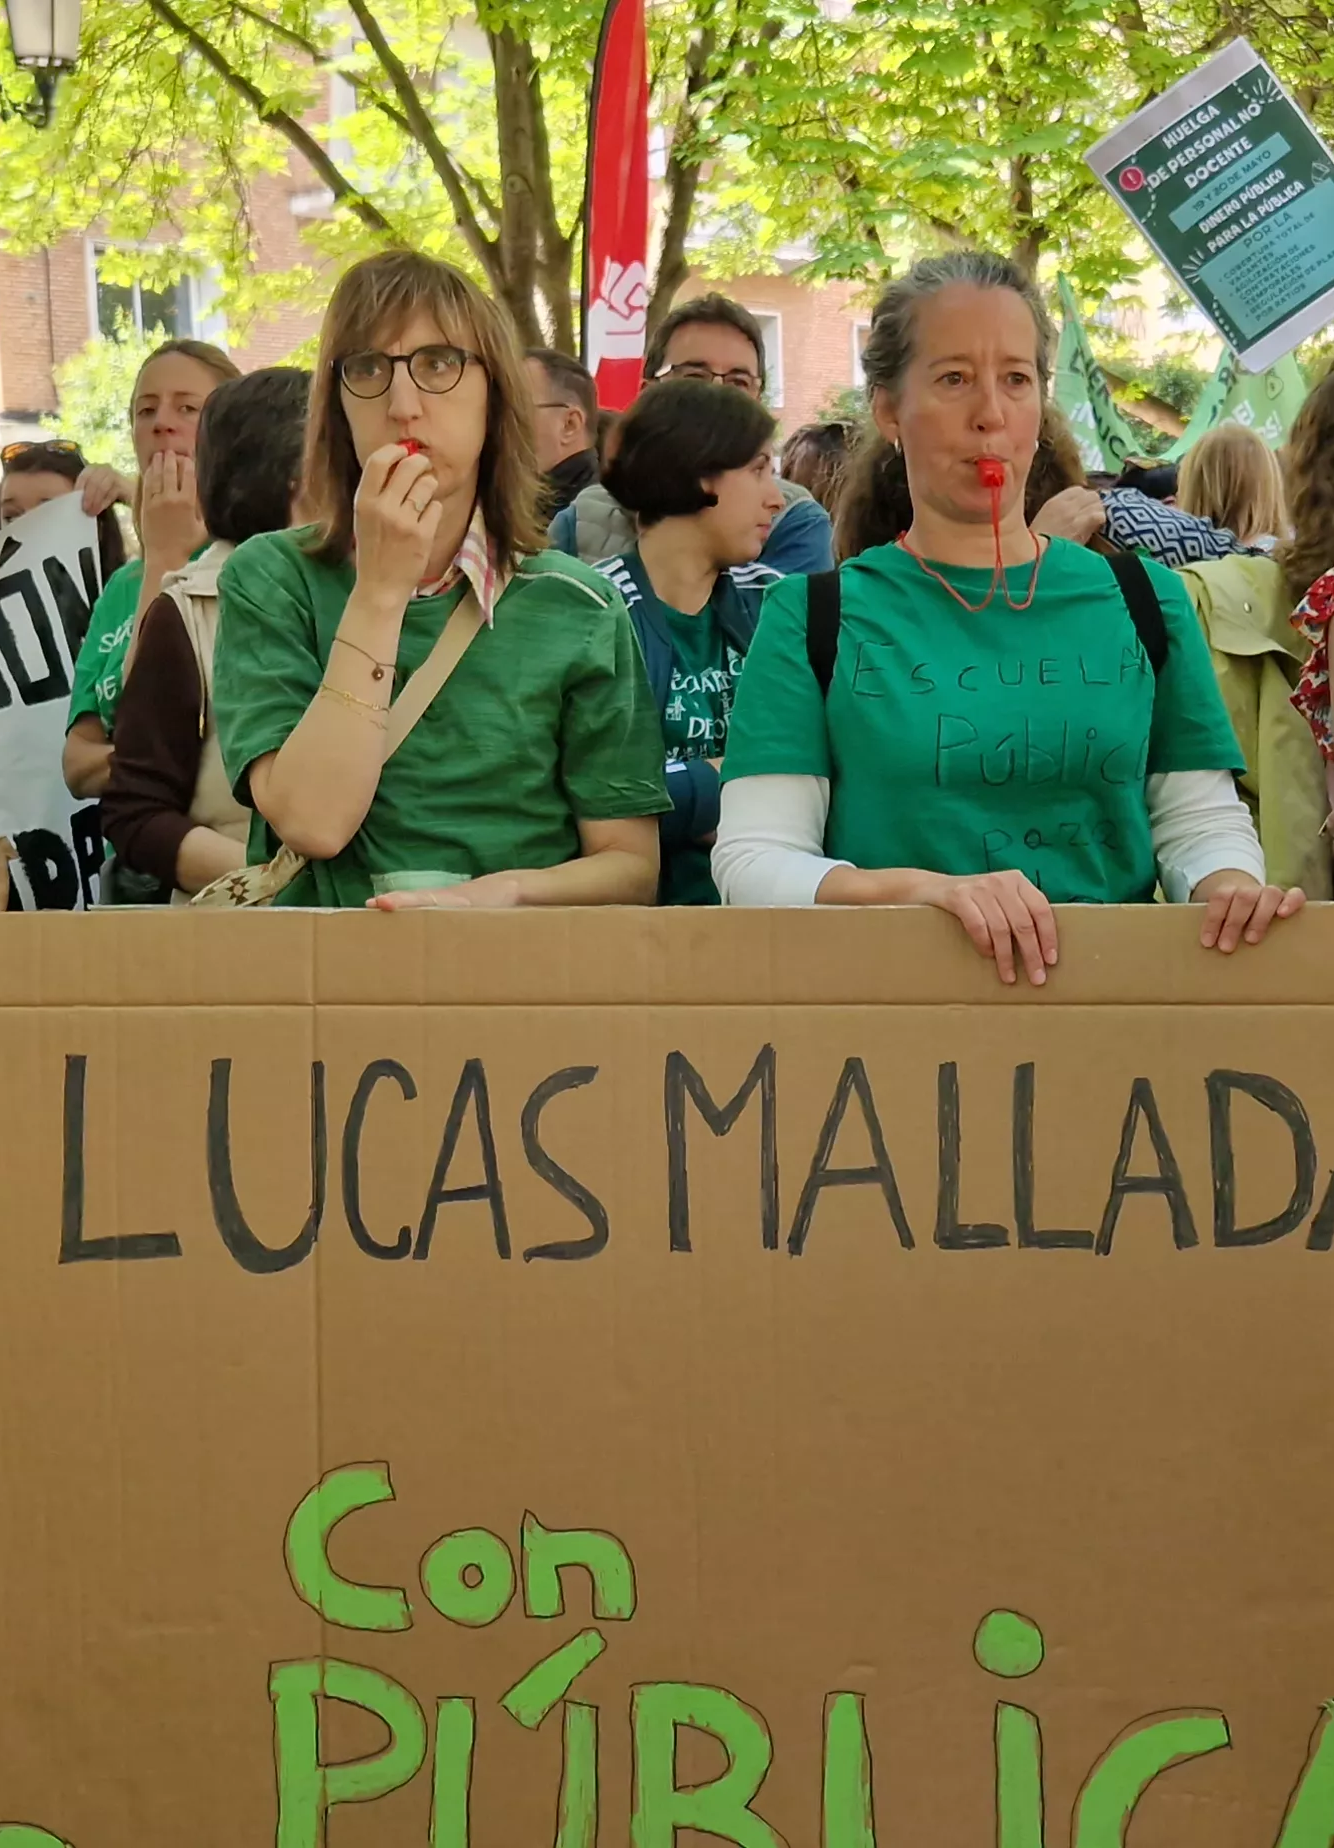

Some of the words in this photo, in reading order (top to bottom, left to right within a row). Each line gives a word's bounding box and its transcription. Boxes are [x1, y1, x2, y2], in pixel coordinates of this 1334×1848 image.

[1147, 167, 1168, 187] DE
[1167, 117, 1239, 172] PERSONAL
[1238, 101, 1262, 123] NO
[1163, 104, 1219, 148] HUELGA
[1185, 137, 1251, 187] DOCENTE
[1226, 171, 1241, 185] DE
[1242, 149, 1271, 173] MAYO
[1198, 198, 1241, 233] DINERO
[1239, 167, 1285, 204] PÚBLICO
[1206, 223, 1241, 253] PARA
[1240, 210, 1258, 229] LA
[1256, 178, 1304, 216] PÚBLICA
[1243, 224, 1272, 247] POR
[1274, 210, 1292, 227] LA
[58, 1053, 609, 1273] LUCAS
